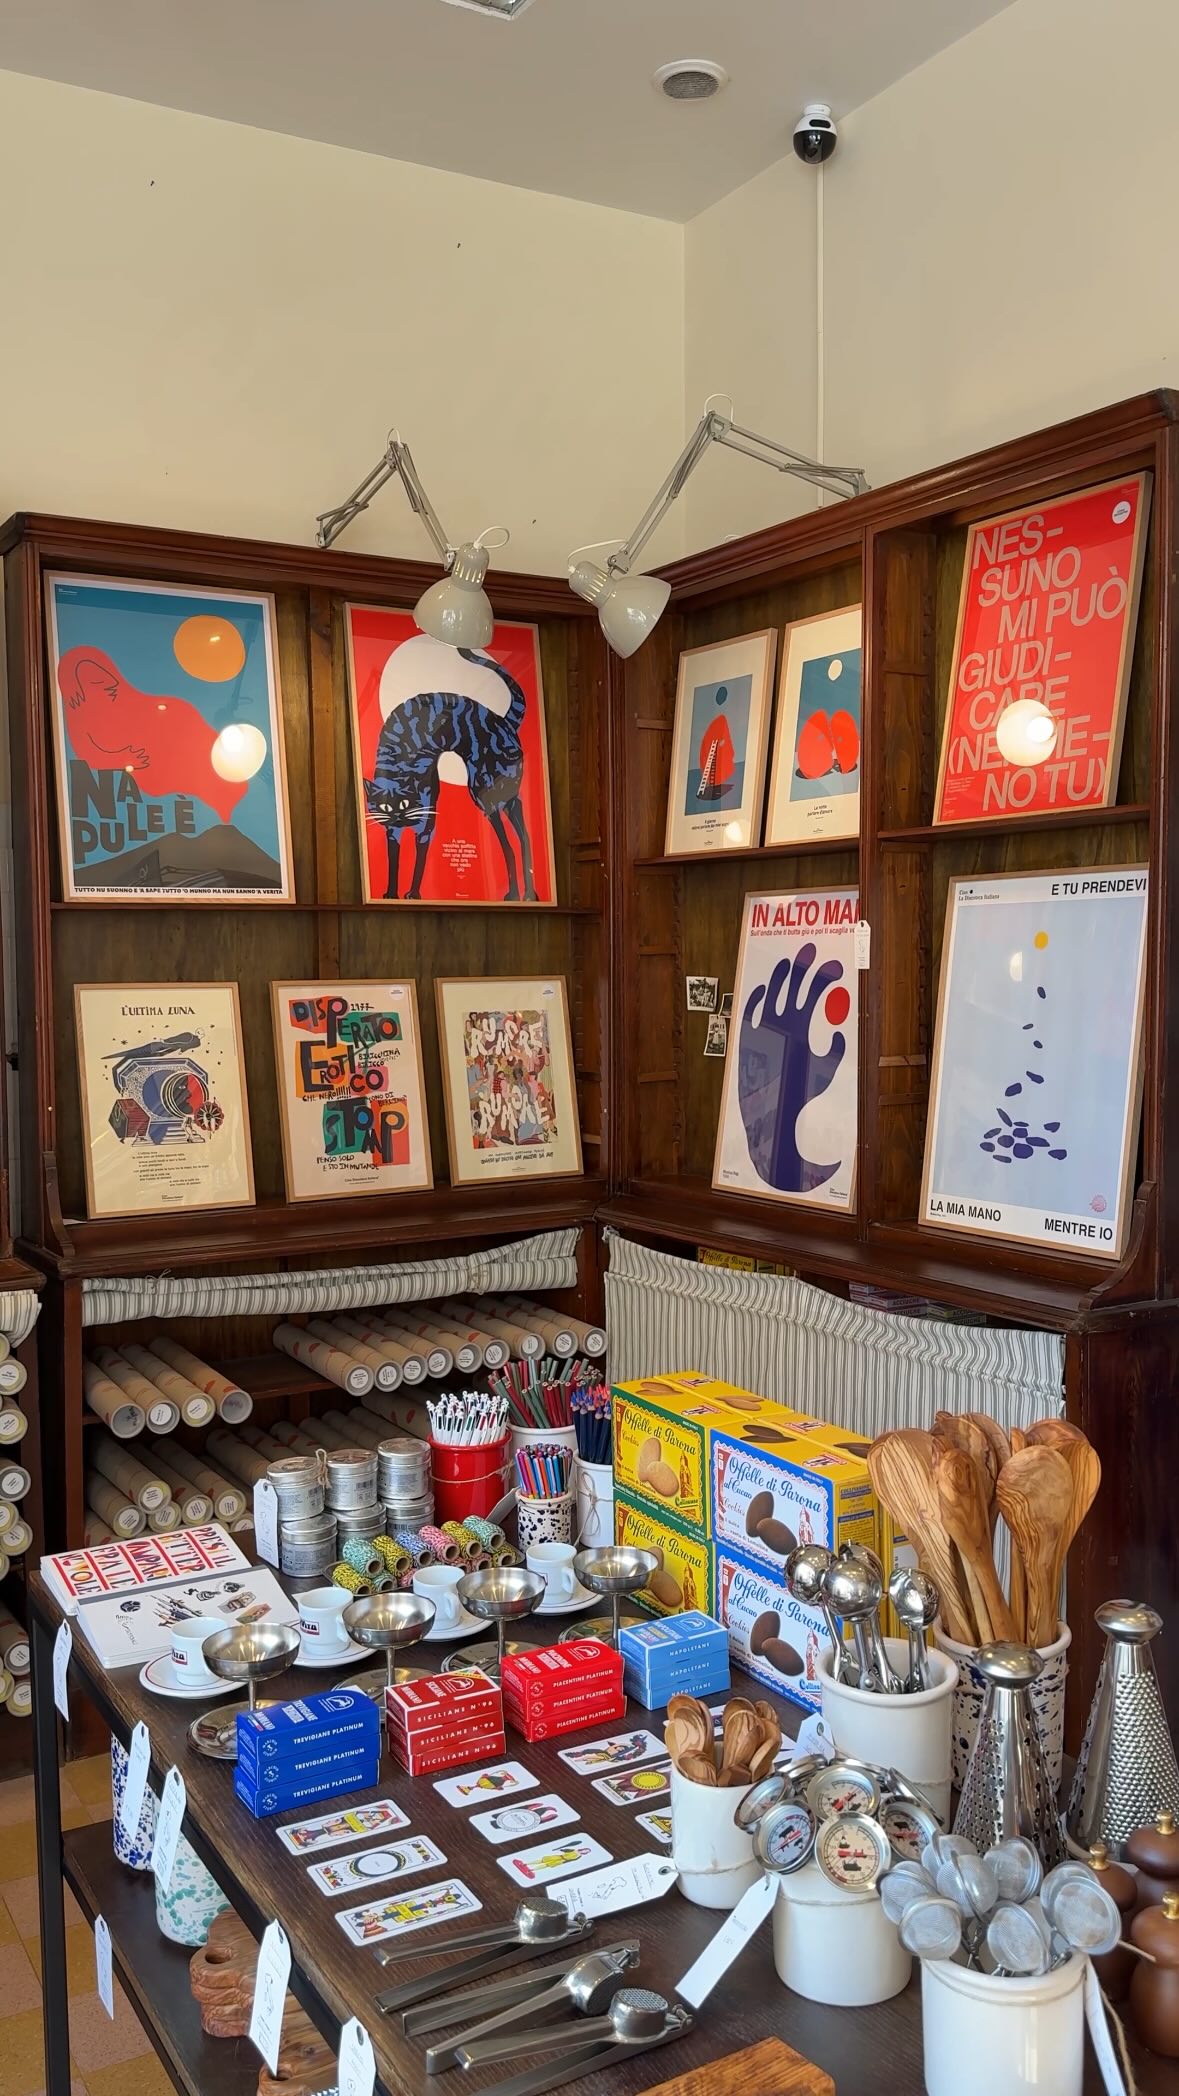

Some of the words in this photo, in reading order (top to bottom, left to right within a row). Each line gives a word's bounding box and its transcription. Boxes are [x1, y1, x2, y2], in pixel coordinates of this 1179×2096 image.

[972, 514, 1064, 569] NES-
[978, 546, 1081, 608] SUNO
[997, 598, 1038, 645] MI
[1045, 567, 1128, 634] PUÒ
[958, 637, 1072, 692] GIUDI-
[948, 715, 1111, 774] (NEE-
[982, 767, 1037, 812] NO
[1045, 757, 1106, 804] TU)
[174, 793, 196, 833] È
[1051, 884, 1059, 896] E
[1062, 882, 1078, 895] TU
[1082, 878, 1147, 894] PRENDEVI
[751, 904, 770, 928] IN
[772, 900, 820, 927] ALTO
[801, 928, 810, 936] giù
[829, 927, 848, 936] scaglia
[122, 1005, 163, 1016] L'ULTIMA
[168, 1006, 196, 1015] LUNA
[292, 997, 398, 1049] DISPERATO
[300, 1040, 384, 1093] EROTICO
[317, 1156, 336, 1164] PENSO
[930, 1199, 944, 1212] LA
[946, 1202, 966, 1216] MIA
[968, 1206, 1001, 1222] MANO
[1044, 1218, 1096, 1238] MENTRE
[1099, 1227, 1113, 1240] IO
[624, 1408, 652, 1435] Offelle
[653, 1425, 662, 1440] di
[663, 1427, 696, 1456] Parona
[724, 1477, 732, 1489] al
[731, 1479, 752, 1500] Cacao
[729, 1456, 764, 1487] Offelle
[766, 1477, 777, 1492] di
[778, 1480, 822, 1513] Parona
[627, 1513, 655, 1543] Offelle
[656, 1535, 665, 1548] di
[666, 1538, 702, 1569] Parona
[728, 1593, 736, 1606] al
[736, 1597, 758, 1618] Cacao
[734, 1572, 770, 1607] Offelle
[772, 1597, 784, 1614] di
[785, 1601, 830, 1637] Parona
[669, 1642, 710, 1656] NAPOLETANE
[553, 1676, 584, 1688] PIACENTINE
[586, 1669, 613, 1680] PLATINUM
[670, 1662, 710, 1677] NAPOLETANE
[553, 1695, 584, 1708] PIACENTINE
[586, 1688, 613, 1699] PLATINUM
[672, 1683, 711, 1697] NAPOLETANE
[417, 1707, 465, 1722] SICILIANE
[557, 1716, 587, 1728] PIACENTINE
[589, 1708, 616, 1719] PLATINUM
[293, 1730, 330, 1744] TREVIGIANE
[332, 1722, 364, 1735] PLATINUM
[420, 1729, 467, 1745] SICILIANE
[295, 1756, 332, 1770] TREVIGIANE
[333, 1747, 365, 1760] PLATINUM
[422, 1750, 469, 1767] SICILIANE
[293, 1783, 330, 1798] TREVIGIANE
[331, 1774, 363, 1788] PLATINUM
